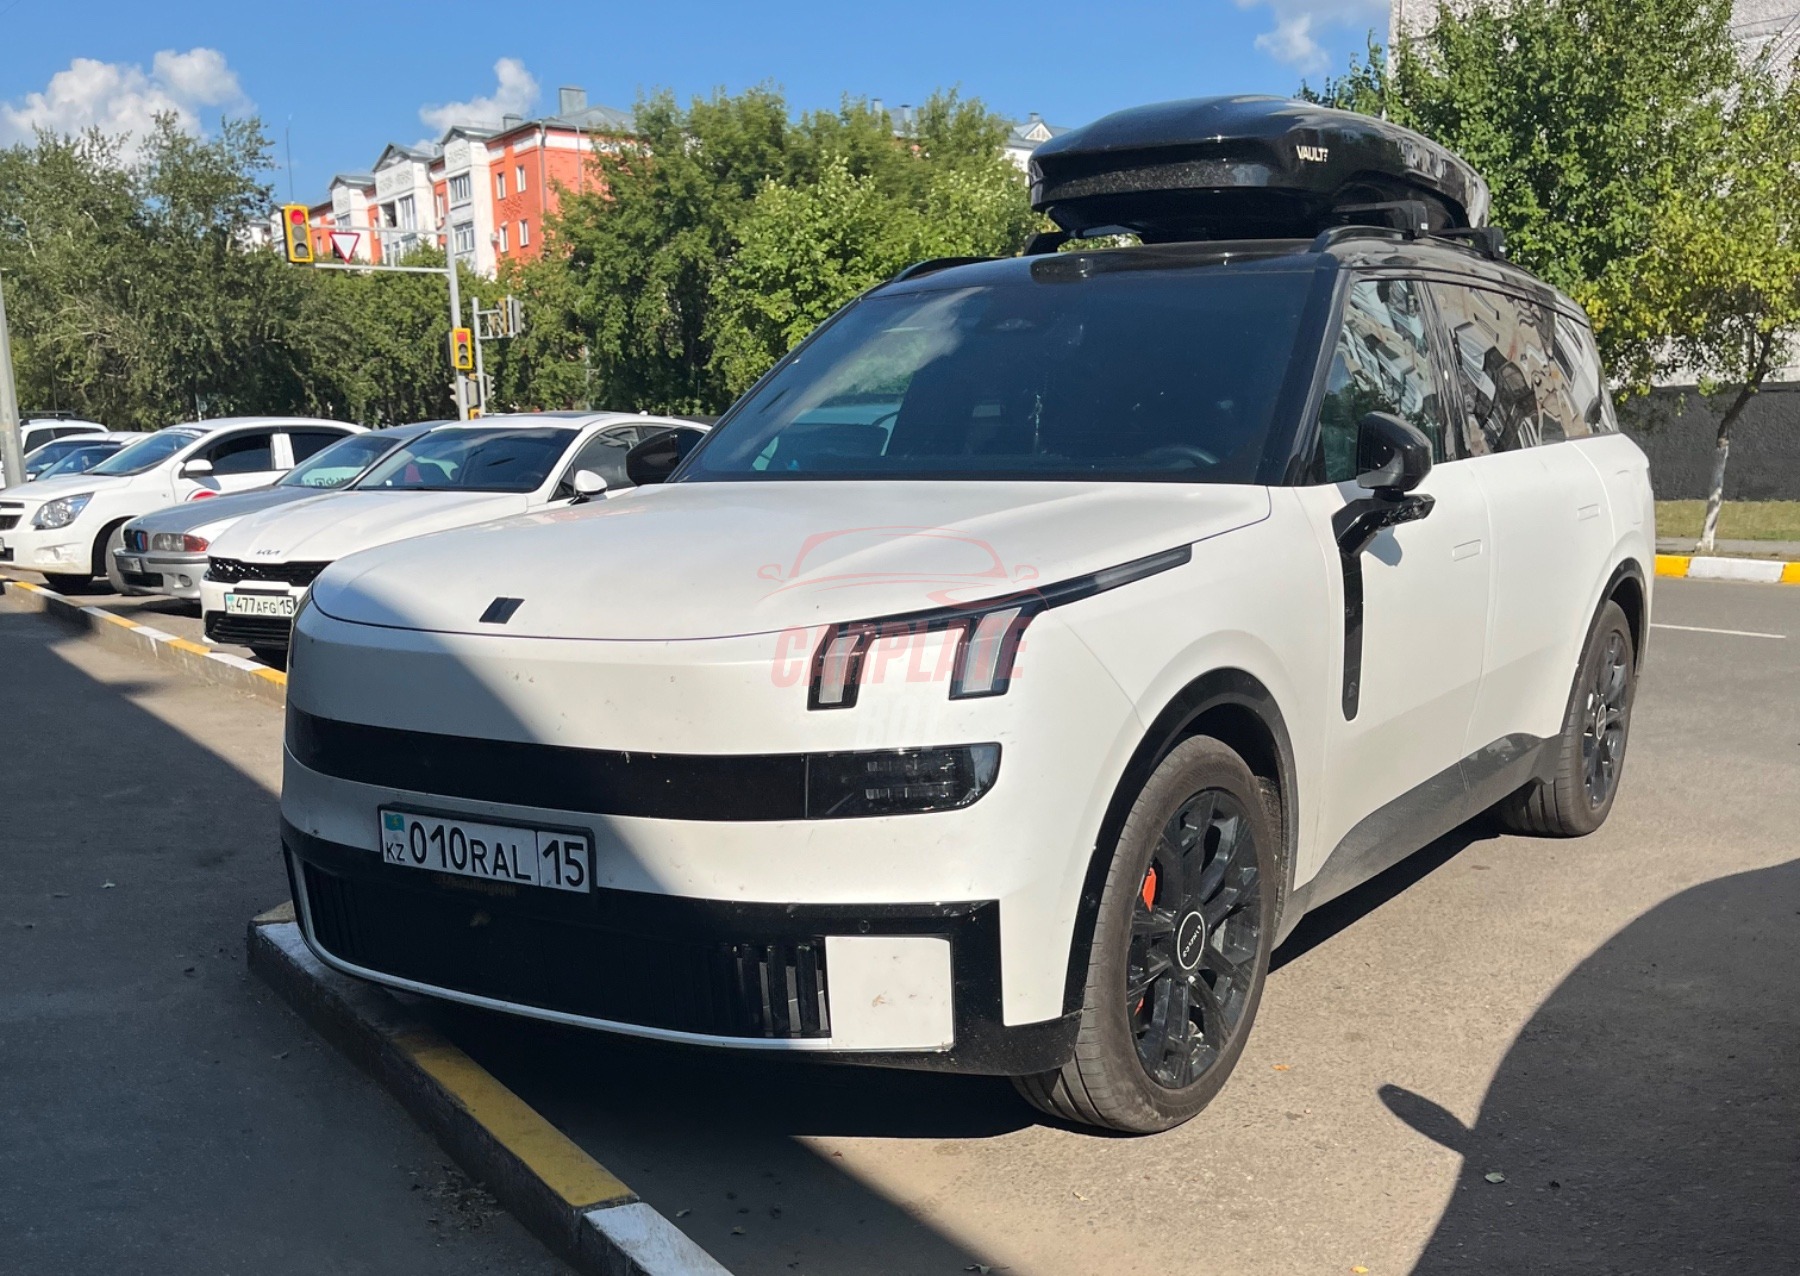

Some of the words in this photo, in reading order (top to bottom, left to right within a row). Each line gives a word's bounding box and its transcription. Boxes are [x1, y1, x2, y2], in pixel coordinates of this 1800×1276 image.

[386, 842, 405, 862] KZ
[409, 821, 532, 881] 010RAL
[542, 839, 584, 887] 15
